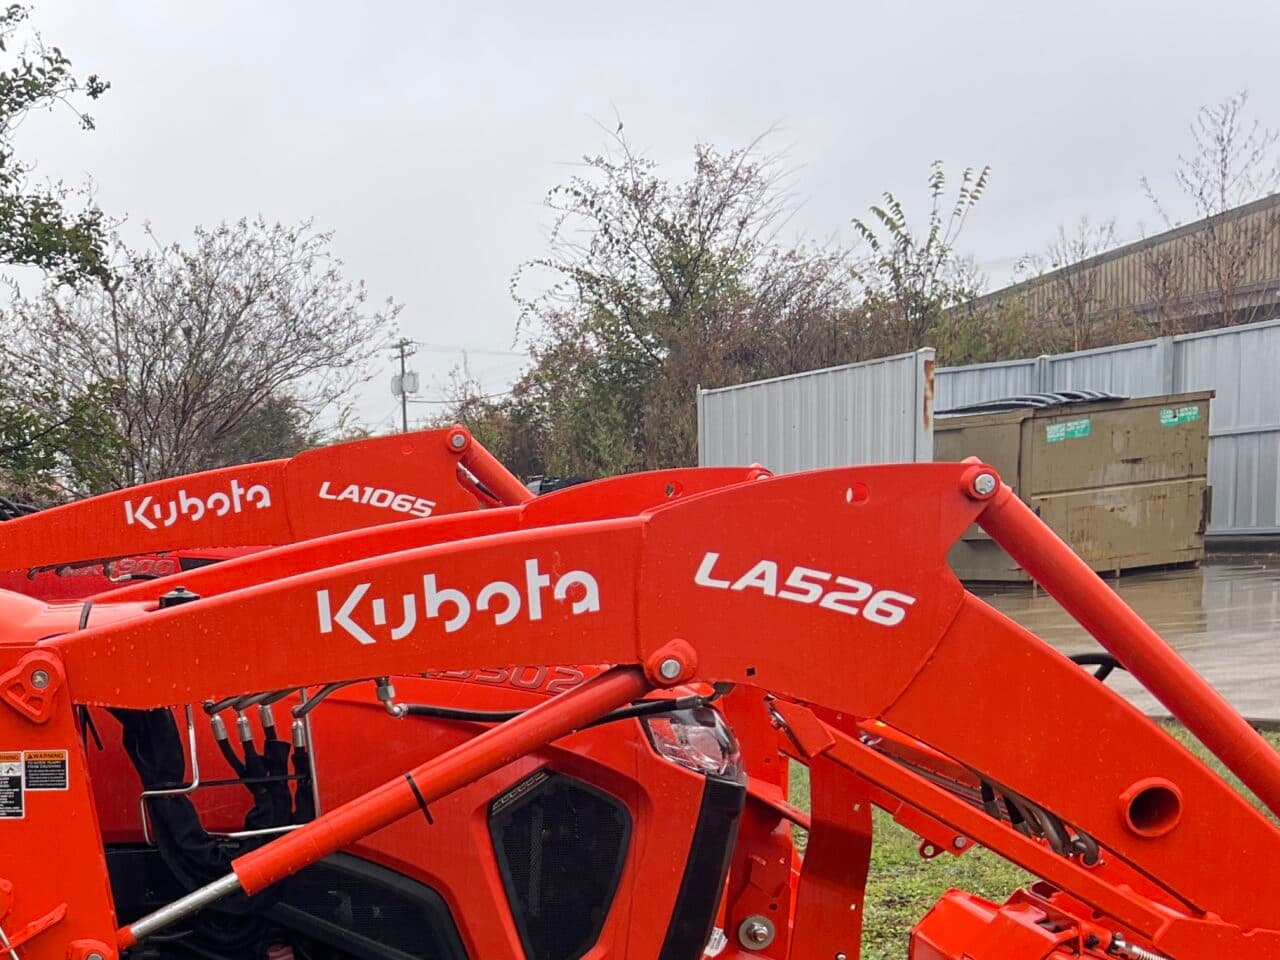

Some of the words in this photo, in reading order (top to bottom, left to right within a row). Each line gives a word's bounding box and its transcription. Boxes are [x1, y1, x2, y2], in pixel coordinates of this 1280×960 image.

[124, 480, 271, 530] Kubota
[319, 481, 437, 518] LA1065
[316, 558, 600, 645] Kubota
[694, 552, 917, 627] LA526
